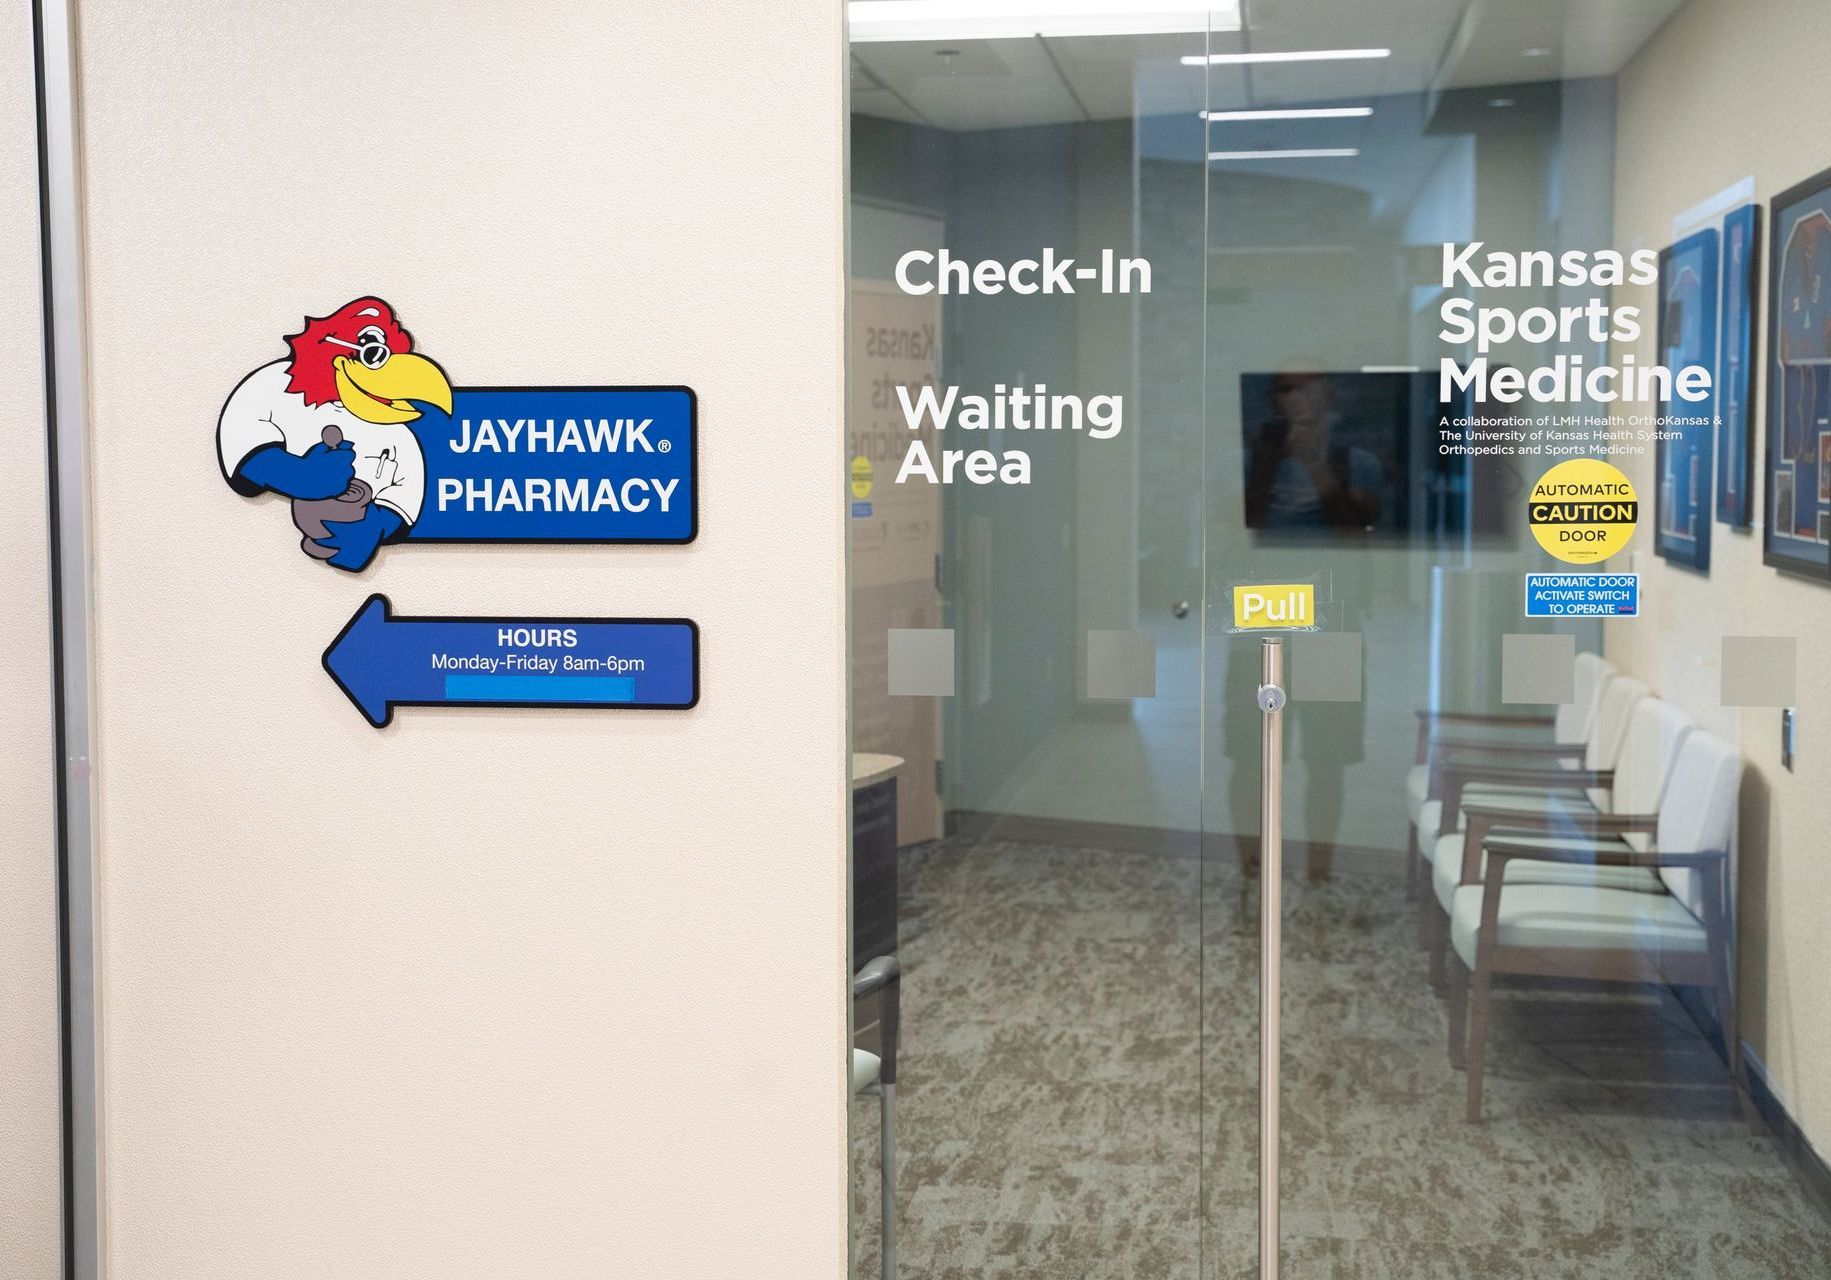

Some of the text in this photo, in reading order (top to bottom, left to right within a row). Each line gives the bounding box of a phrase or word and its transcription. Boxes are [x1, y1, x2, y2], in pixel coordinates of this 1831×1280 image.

[894, 248, 1152, 296] Check-In
[1442, 242, 1658, 288] Kansas
[1439, 298, 1641, 353] Sports
[1440, 355, 1712, 403] Medicine
[895, 384, 1123, 439] Waiting
[1439, 416, 1722, 427] A collaboration of LMH Health OrthoKansas &
[1439, 430, 1683, 443] The University of Kansas Health System
[1439, 444, 1645, 457] Orthopedics and Sports Medicine
[894, 440, 1031, 484] Area
[438, 478, 680, 512] PHARMACY
[1535, 484, 1629, 496] AUTOMATIC
[1532, 504, 1632, 521] CAUTION
[1559, 530, 1606, 542] DOOR
[1530, 577, 1635, 587] AUTOMATIC DOOR
[1535, 590, 1630, 600] ACTIVATE SWITCH
[1243, 592, 1305, 620] Pull
[1548, 604, 1564, 614] TO
[1566, 604, 1615, 614] OPERATE
[498, 629, 577, 647] HOURS
[432, 654, 645, 675] Monday-Friday 8am-6pm
